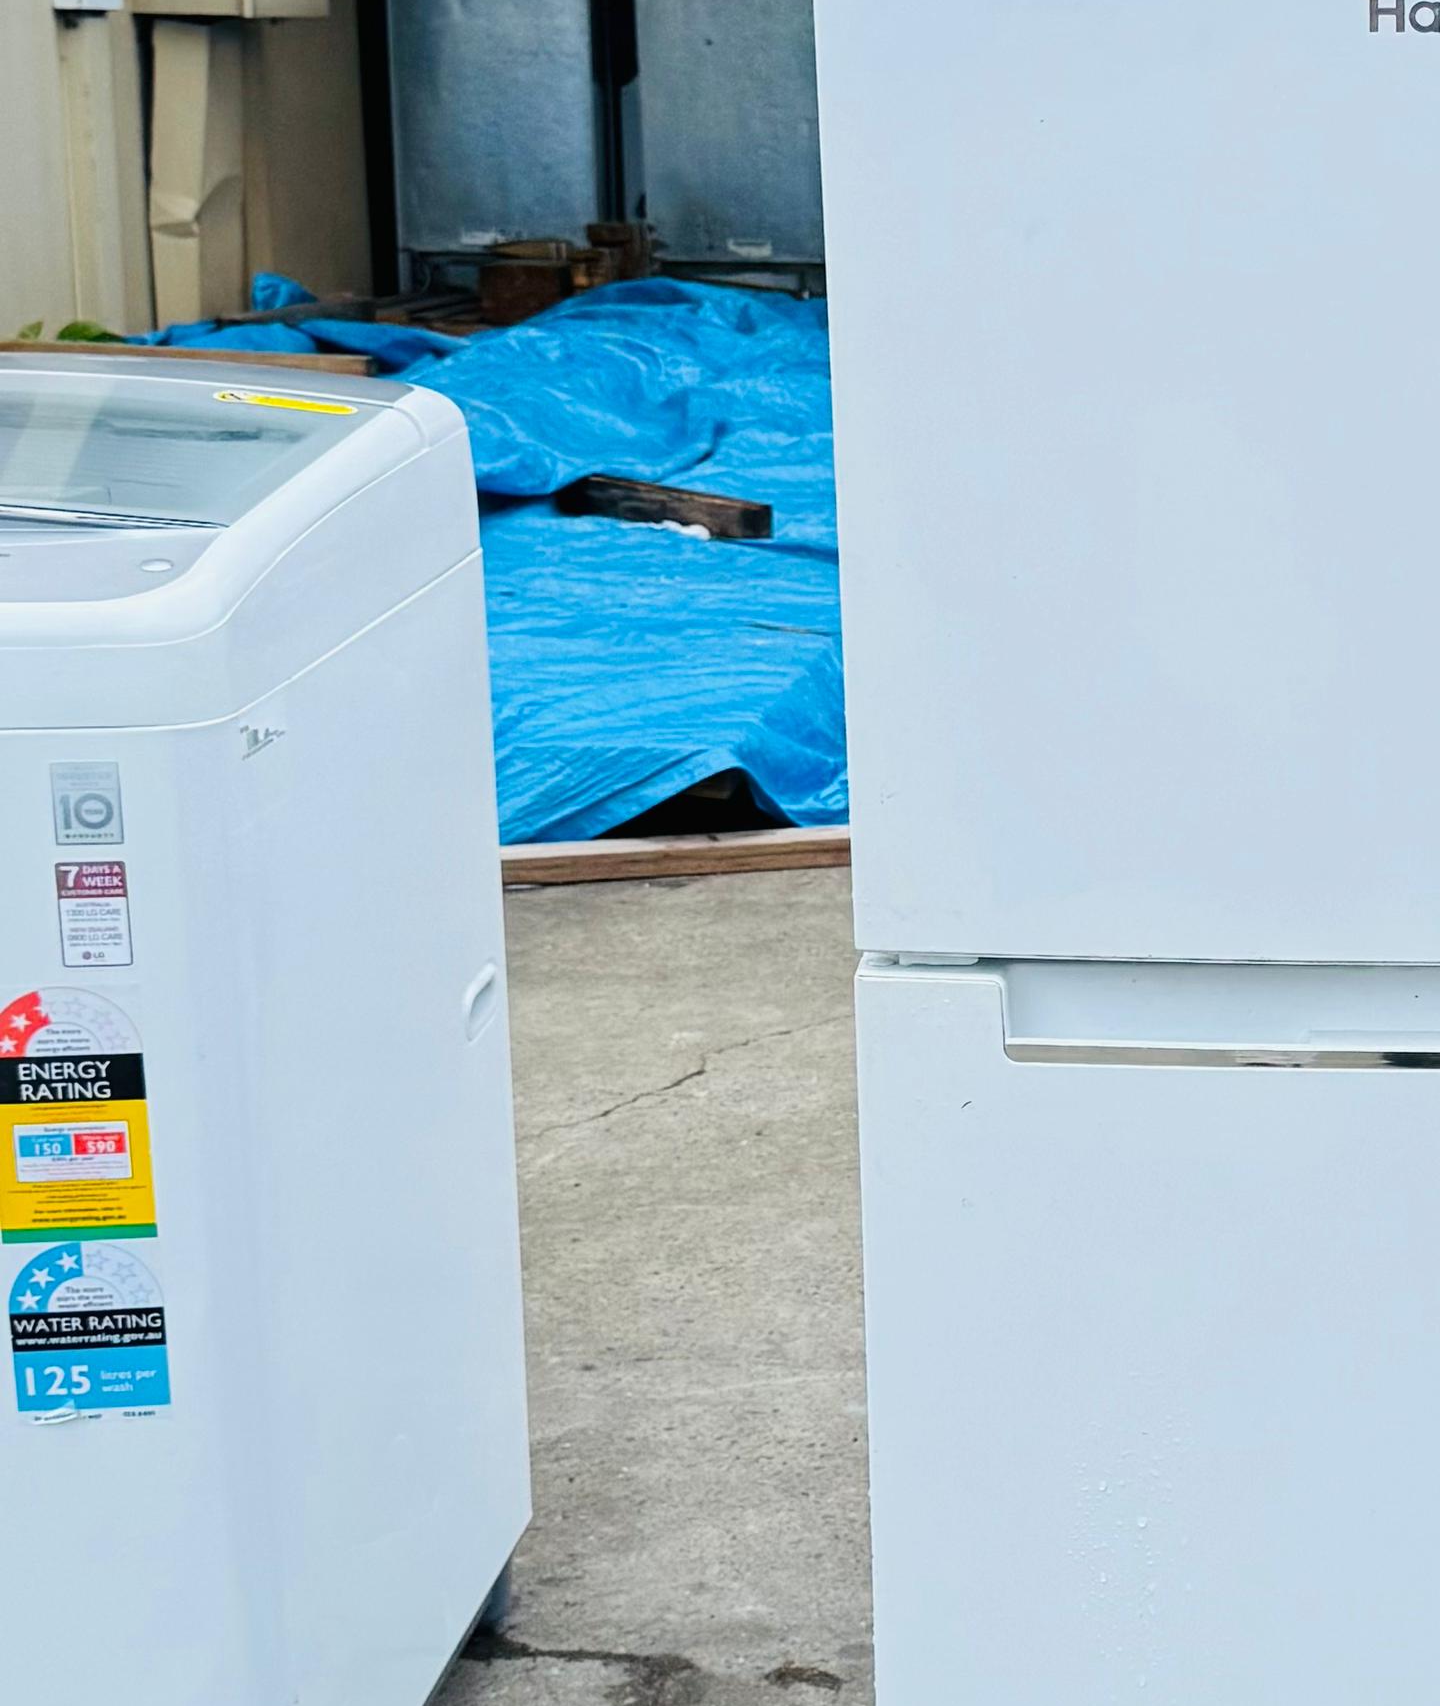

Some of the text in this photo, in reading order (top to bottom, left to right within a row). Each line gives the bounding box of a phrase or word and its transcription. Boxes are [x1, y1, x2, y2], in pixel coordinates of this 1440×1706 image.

[58, 866, 79, 887] 7
[82, 865, 121, 874] DAYS A
[82, 876, 123, 887] WEEK
[100, 908, 121, 916] CARE
[18, 1060, 111, 1081] ENERGY
[20, 1081, 112, 1101] RATING
[34, 1140, 116, 1155] 150 590
[13, 1313, 162, 1334] WATER RATING
[15, 1331, 162, 1345] www.waterrating.gov.au
[25, 1364, 91, 1397] 125
[135, 1370, 157, 1381] per
[102, 1382, 133, 1392] wash
